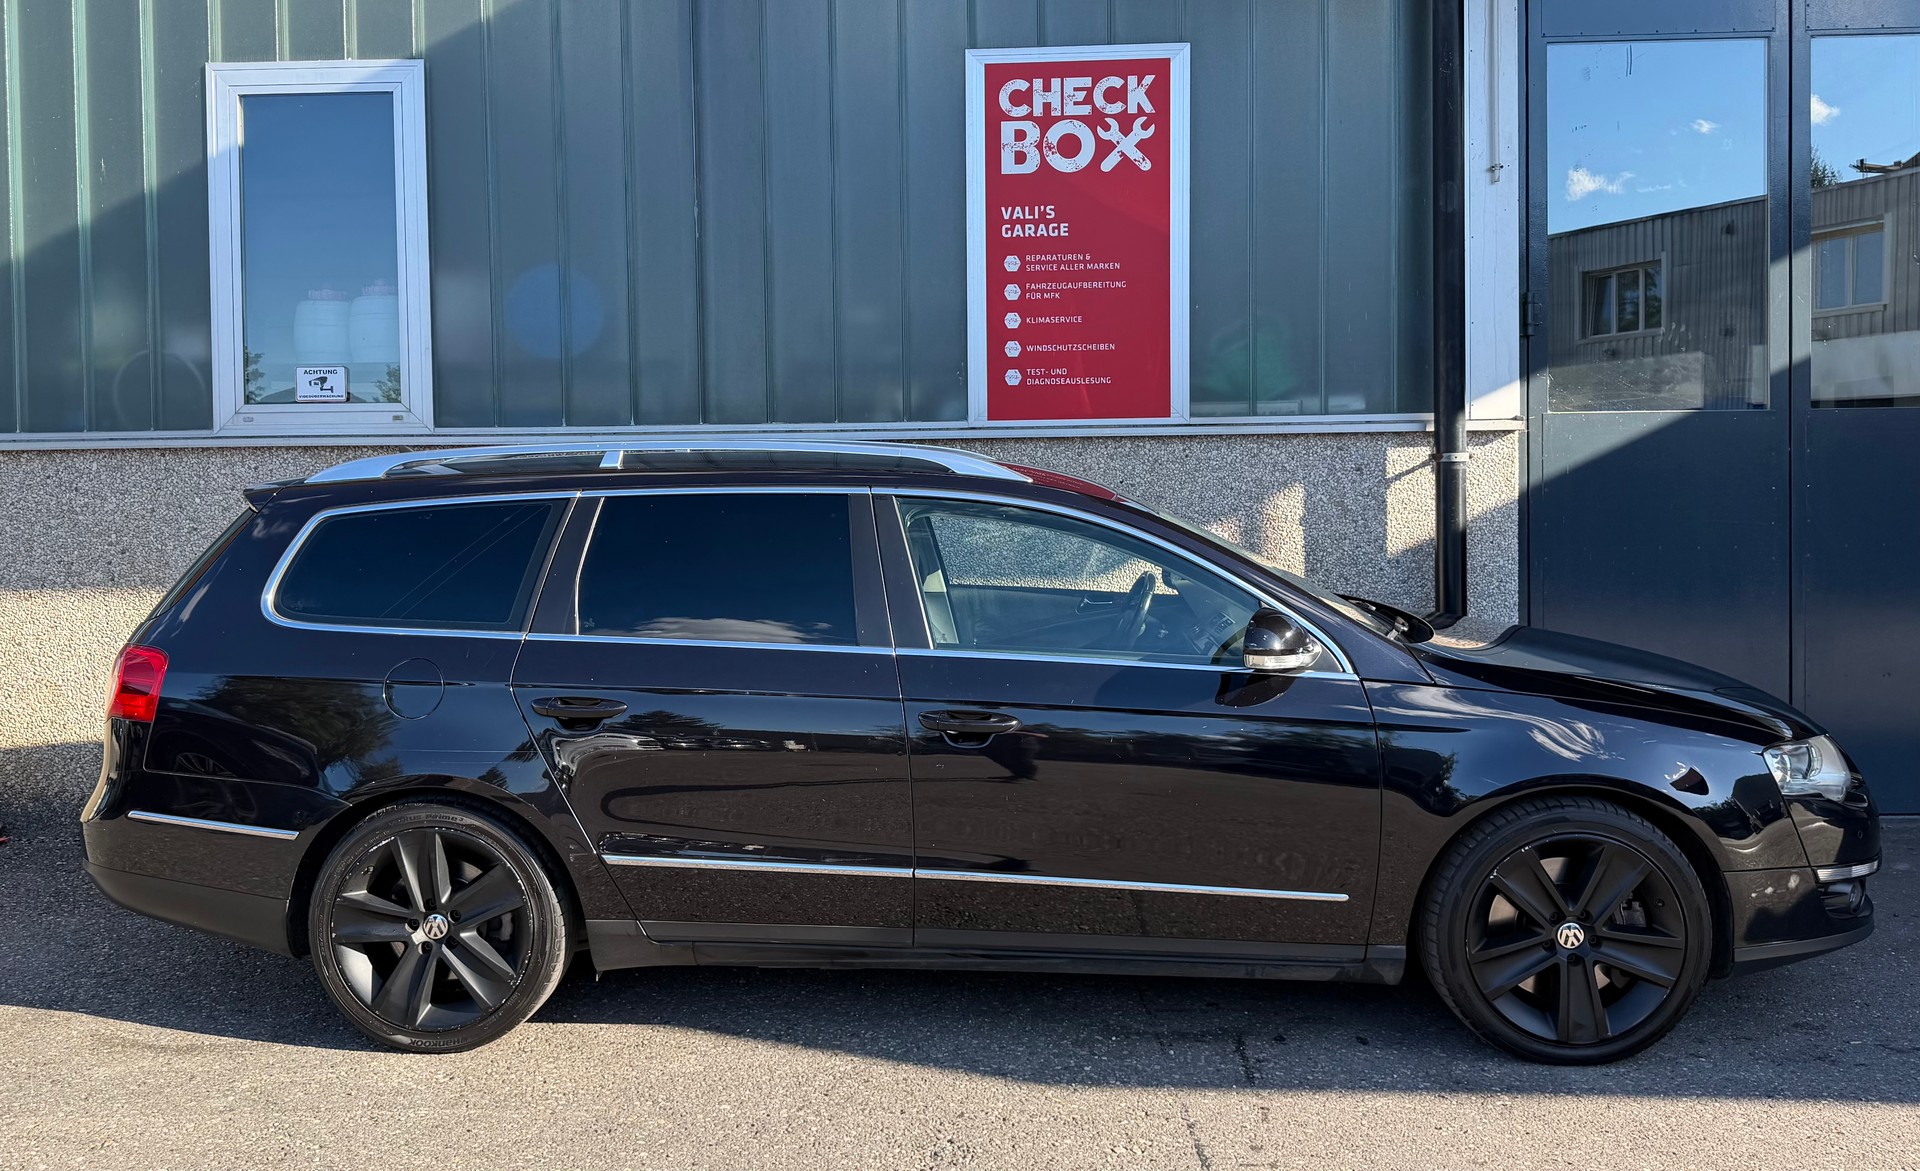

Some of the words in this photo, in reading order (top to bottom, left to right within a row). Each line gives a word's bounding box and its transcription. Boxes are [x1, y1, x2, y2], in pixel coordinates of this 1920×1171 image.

[999, 75, 1155, 117] CHECK
[1001, 205, 1055, 219] VALI'S
[1002, 223, 1068, 237] GARAGE
[1026, 253, 1084, 261] REPARATUREN
[1085, 253, 1091, 261] &
[1026, 263, 1058, 271] SERVICE
[1026, 281, 1126, 289] FAHRZEUGAUFBEREITUNG
[1026, 291, 1042, 299] FÜR
[1027, 315, 1083, 323] KLIMASERVICE
[1027, 343, 1115, 351] WINDSCHUTZSCHEIBEN
[1051, 367, 1068, 375] UND
[1027, 377, 1112, 385] DIAGNOSEAUSLESUNG
